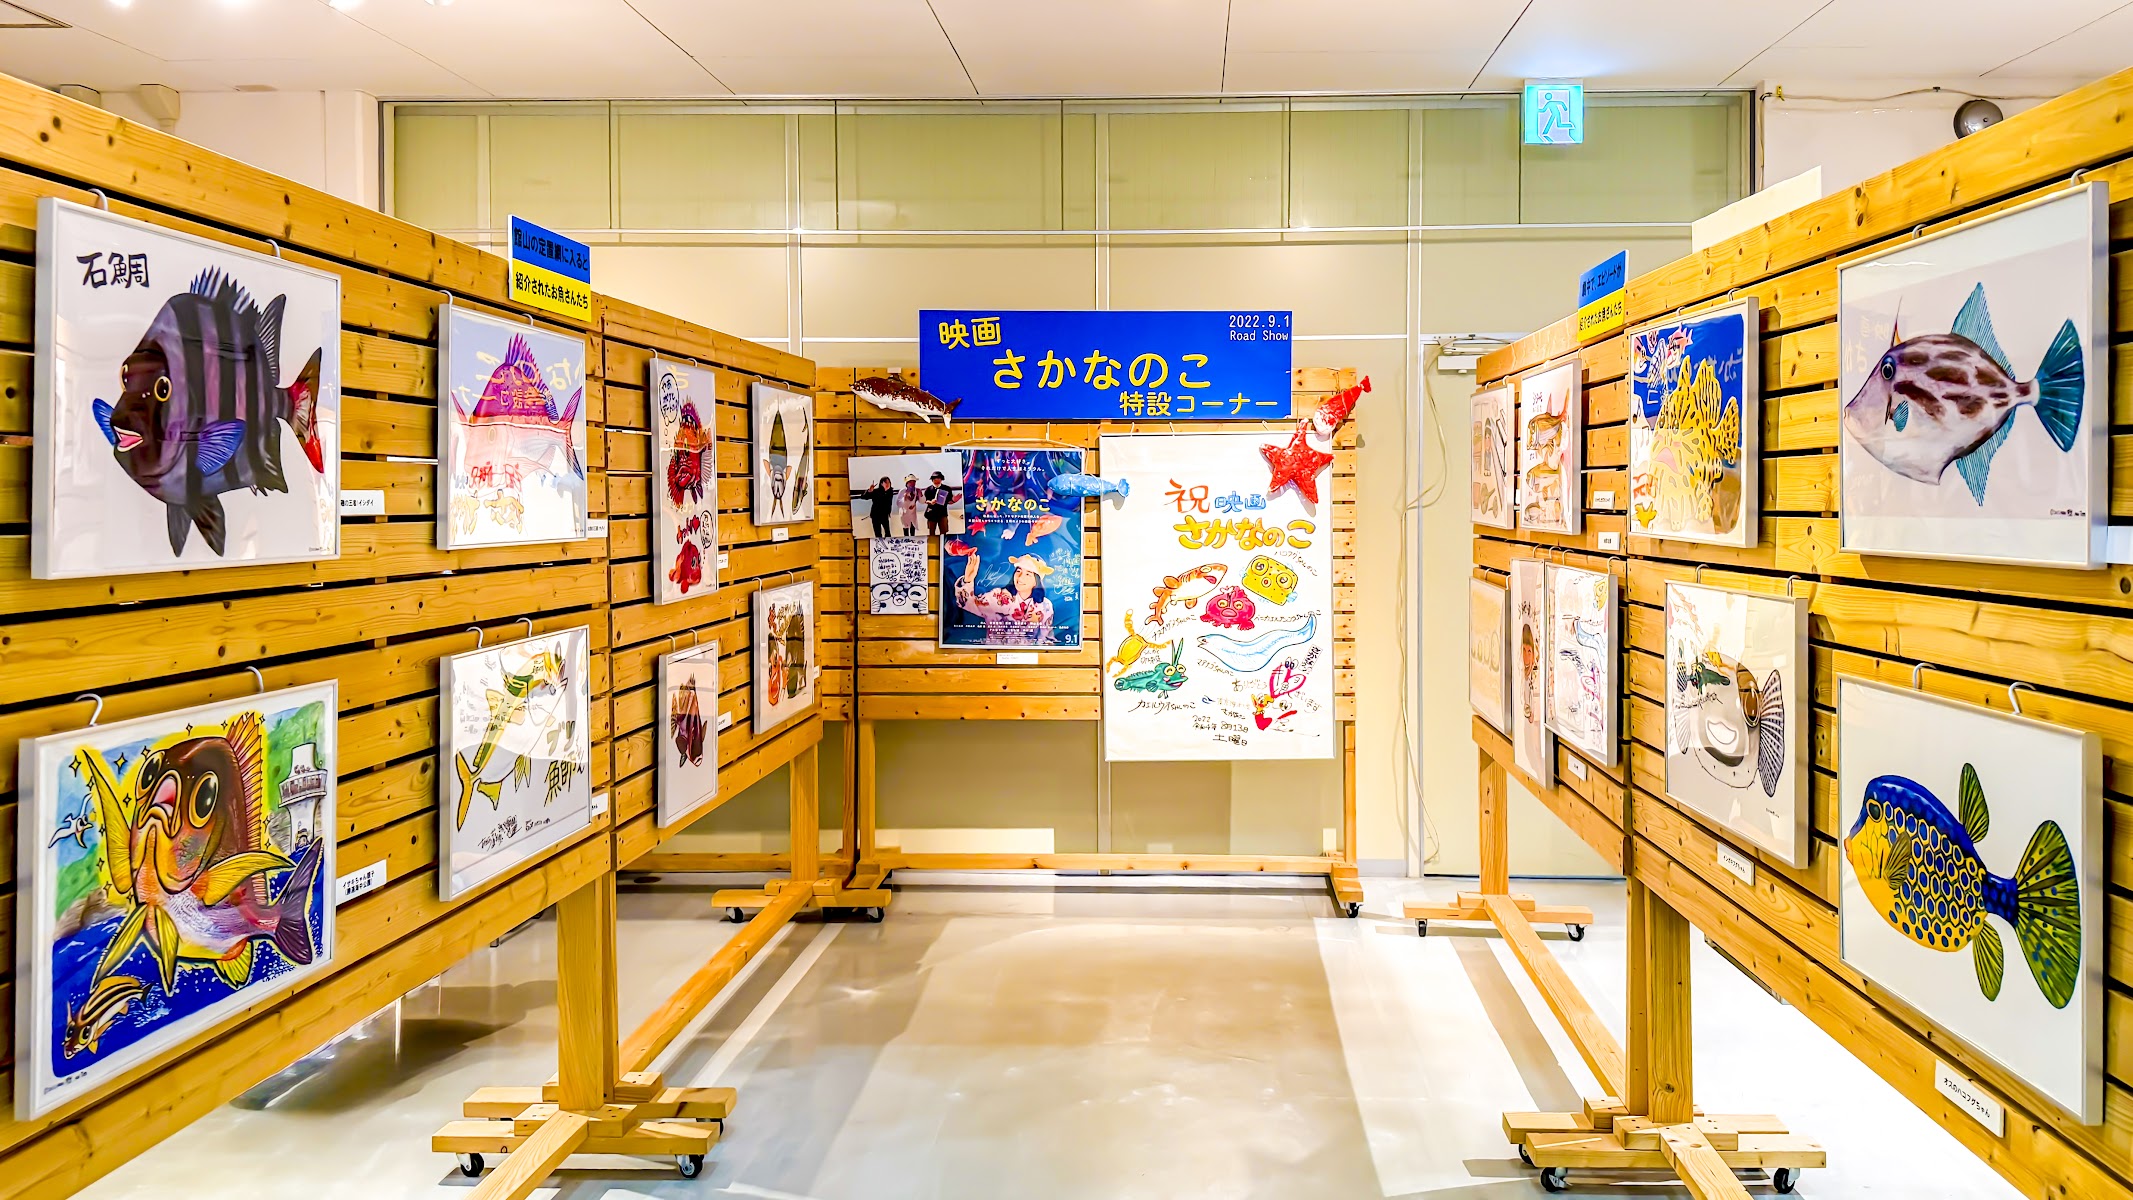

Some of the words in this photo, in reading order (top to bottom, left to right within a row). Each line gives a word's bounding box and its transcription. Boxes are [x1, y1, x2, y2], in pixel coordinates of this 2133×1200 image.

[513, 226, 588, 272] 館山の定置網に入ると
[76, 252, 149, 289] 石鯛
[514, 271, 589, 310] 紹介されたお魚さんたち
[938, 316, 1002, 350] 映画
[1229, 314, 1290, 328] 2022.9.1
[1579, 300, 1623, 332] 紹介されたお魚さんたち
[1229, 330, 1256, 341] Road
[1262, 330, 1289, 341] Show
[992, 348, 1212, 390] さかなのこ
[1119, 391, 1279, 416] 特設コーナー
[975, 496, 1051, 513] さかなのこ
[1163, 478, 1211, 513] 祝
[1214, 490, 1267, 514] 映画
[1173, 515, 1316, 551] さかなのこ
[1065, 634, 1077, 643] 9.1
[1212, 733, 1248, 746] 土曜日
[1943, 1076, 1991, 1119] オスのハコフグちゃん
